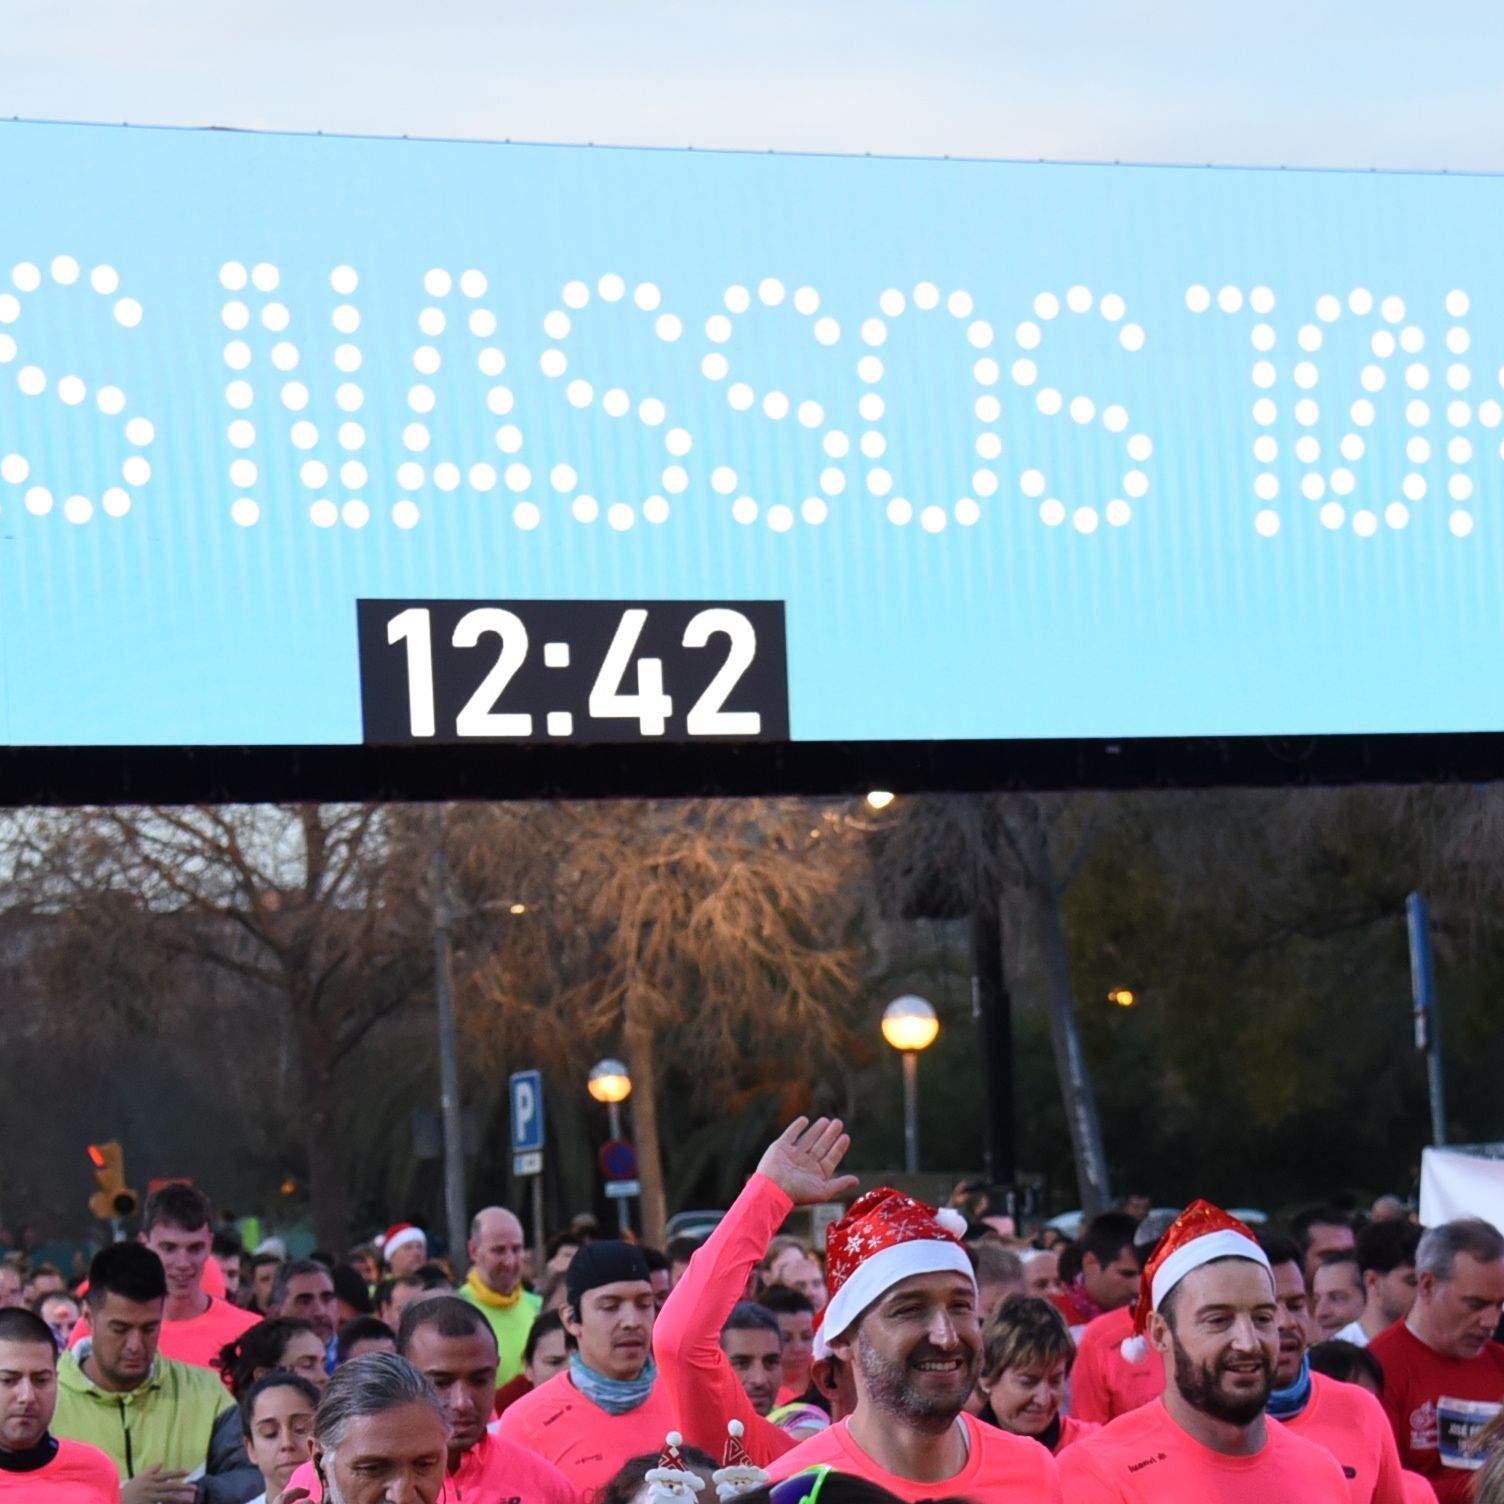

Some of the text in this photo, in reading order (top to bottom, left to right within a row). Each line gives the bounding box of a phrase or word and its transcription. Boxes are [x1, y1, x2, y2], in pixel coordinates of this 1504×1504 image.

[219, 261, 1153, 538] NASSOS
[386, 607, 762, 737] 12:42
[515, 1081, 535, 1142] P
